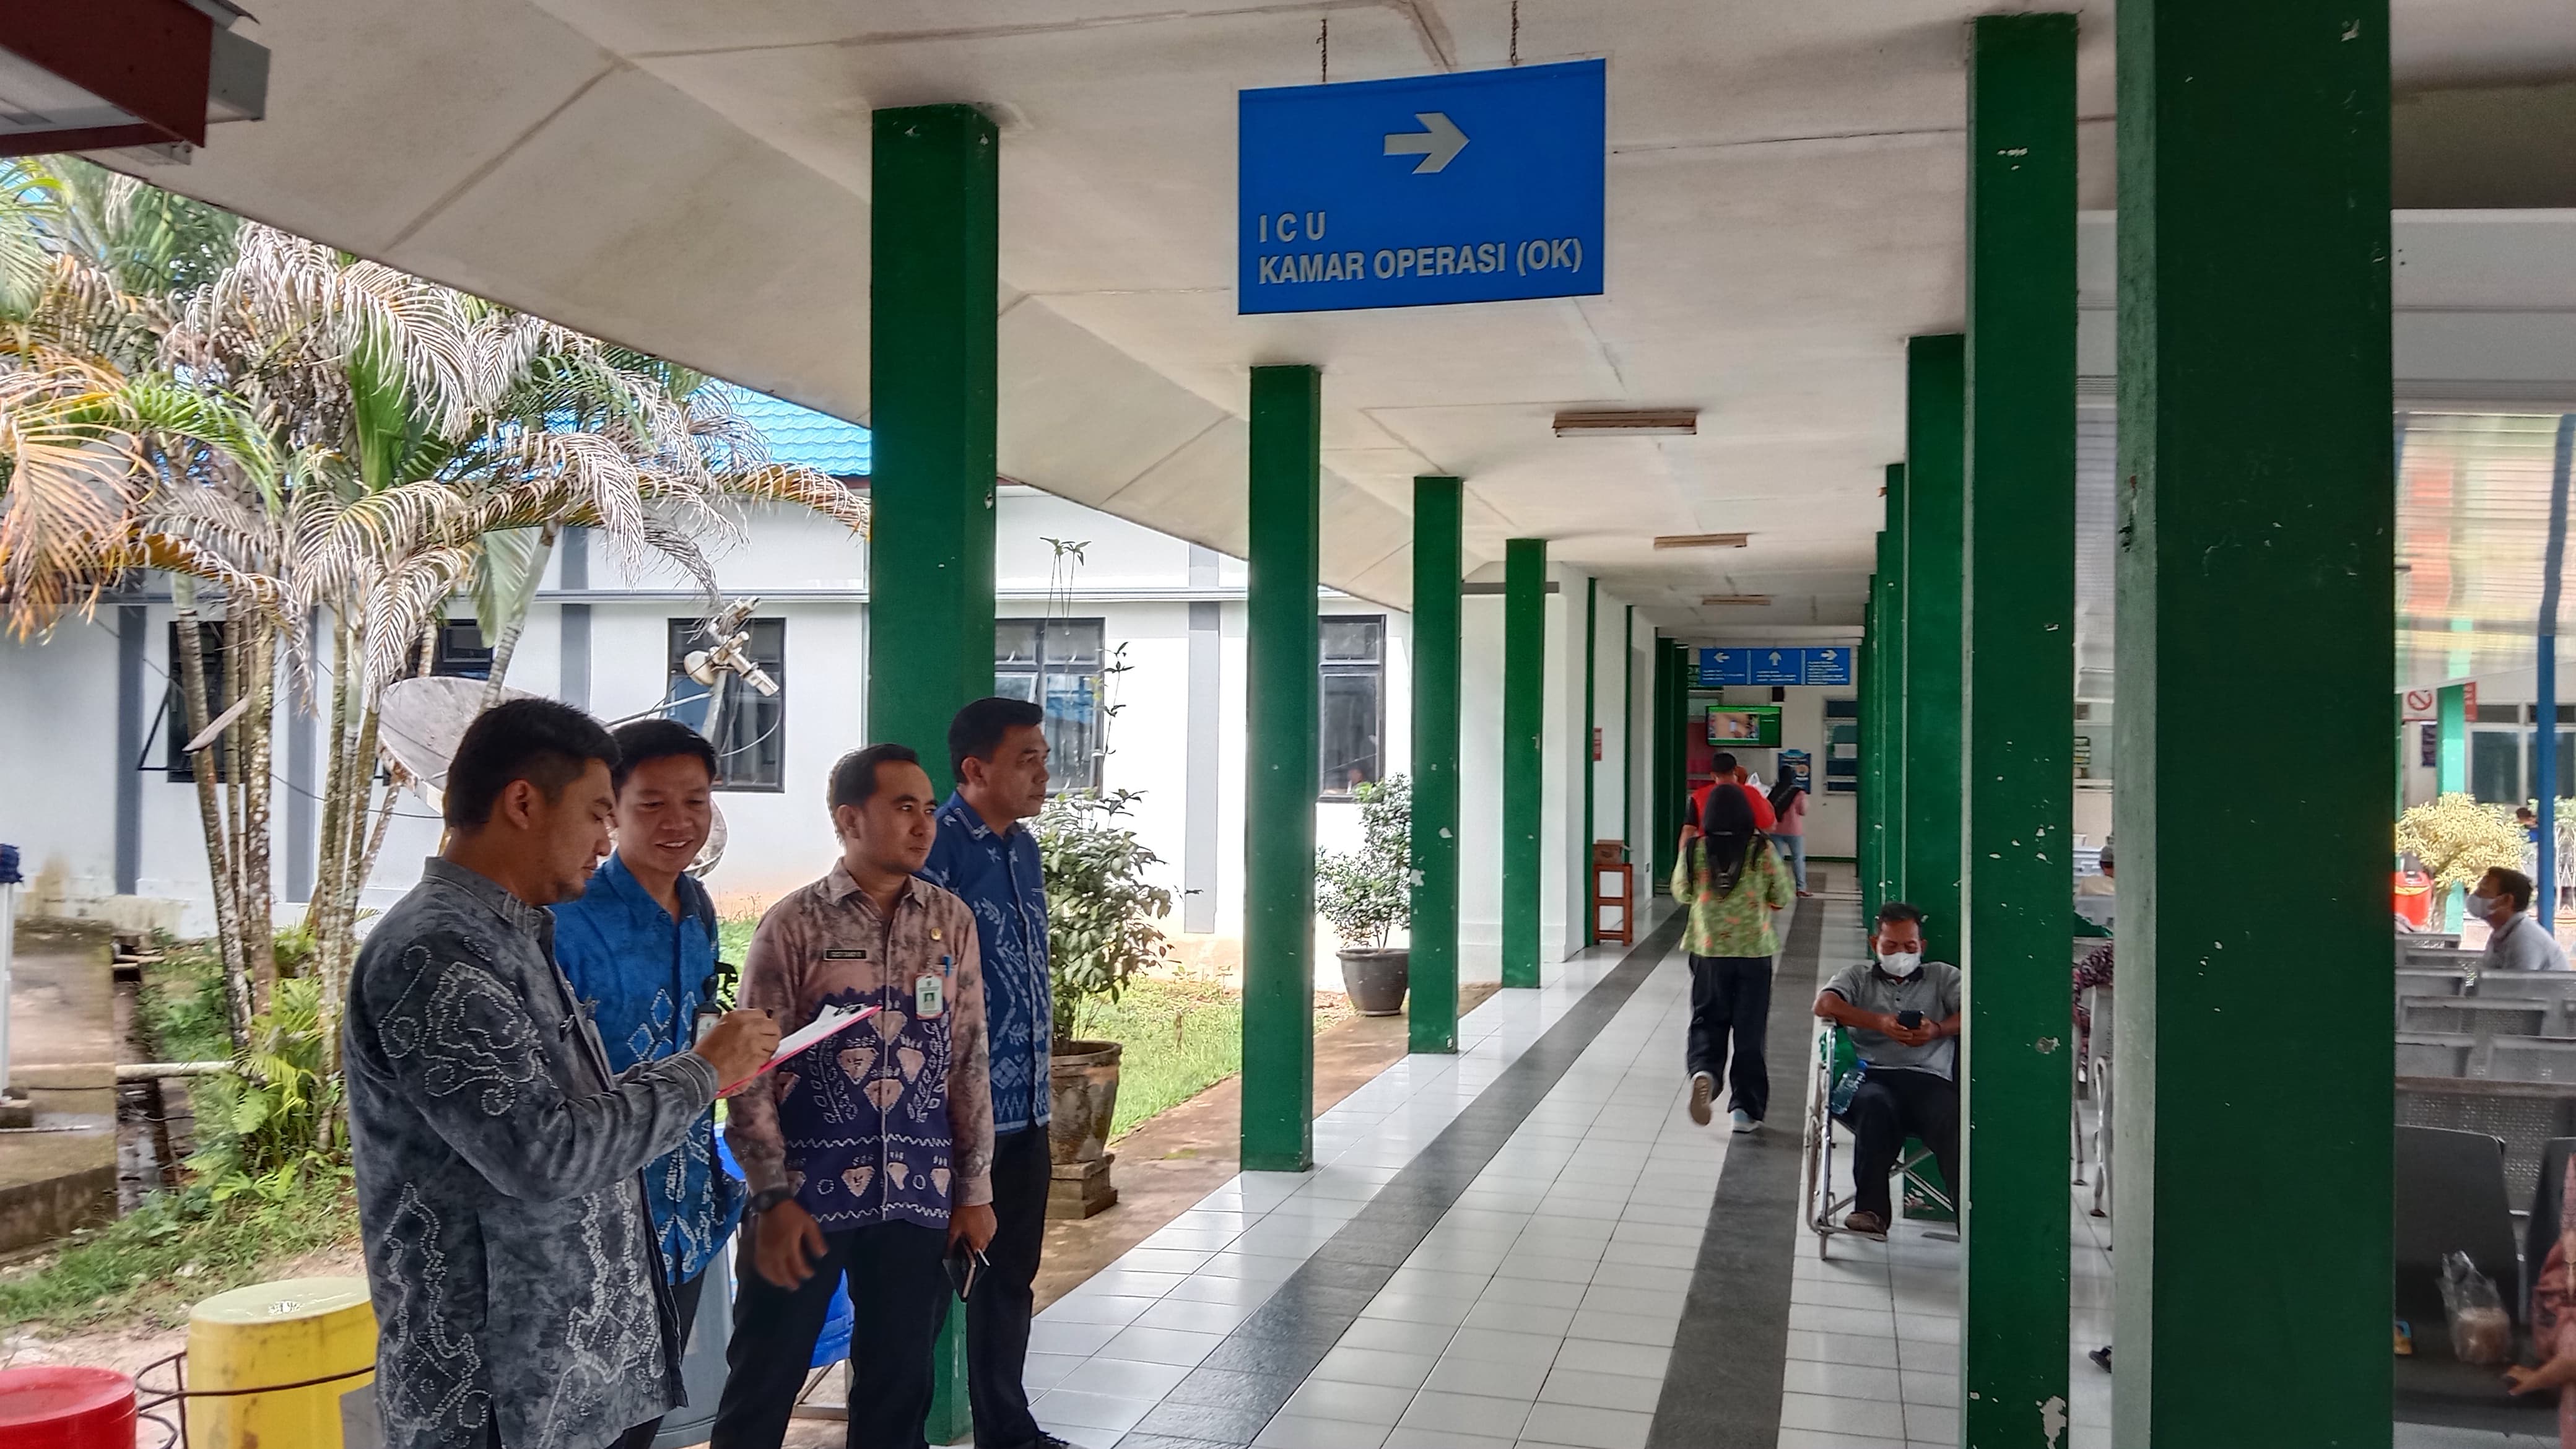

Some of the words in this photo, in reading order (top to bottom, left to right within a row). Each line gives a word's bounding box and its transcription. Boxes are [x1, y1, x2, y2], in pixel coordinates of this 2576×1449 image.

[1259, 251, 1364, 284] KAMAR
[1373, 243, 1505, 279] OPERASI
[1516, 238, 1582, 276] (OK)
